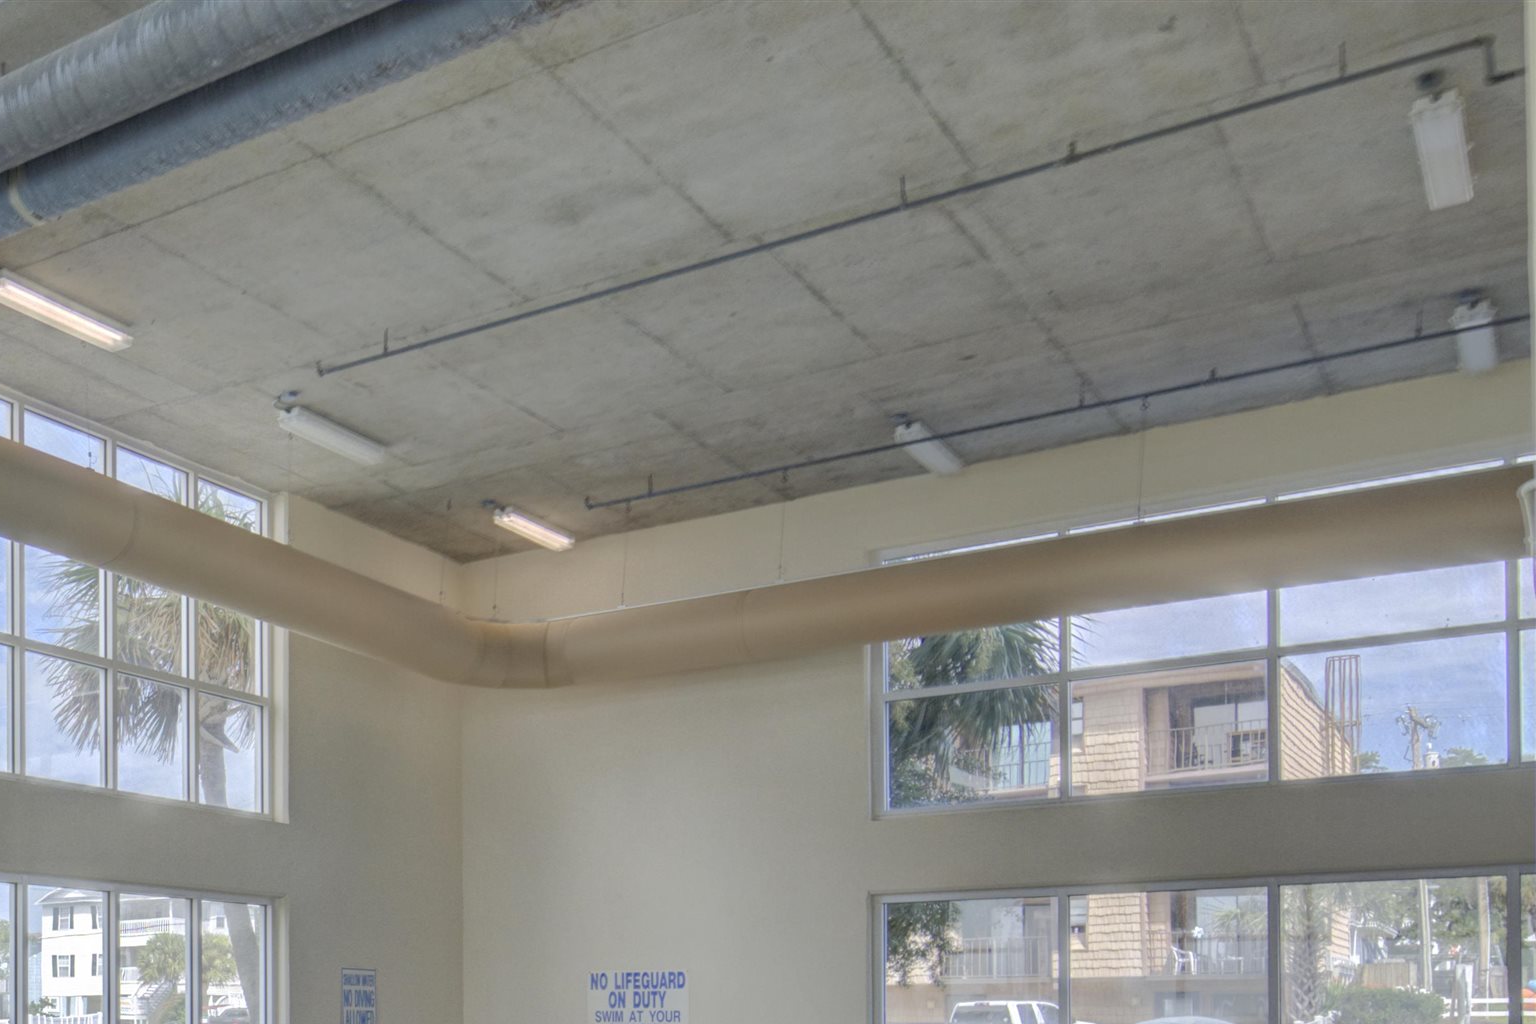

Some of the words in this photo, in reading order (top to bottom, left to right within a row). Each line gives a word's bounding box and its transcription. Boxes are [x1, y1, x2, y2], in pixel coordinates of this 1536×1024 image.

[590, 972, 608, 990] NO
[614, 971, 686, 990] LIFEGUARD
[344, 989, 353, 1007] NO
[355, 989, 375, 1008] DIVING
[608, 991, 626, 1008] ON
[633, 991, 667, 1008] DUTY
[595, 1010, 624, 1023] SWIM
[629, 1010, 644, 1022] AT
[649, 1010, 681, 1023] YOUR
